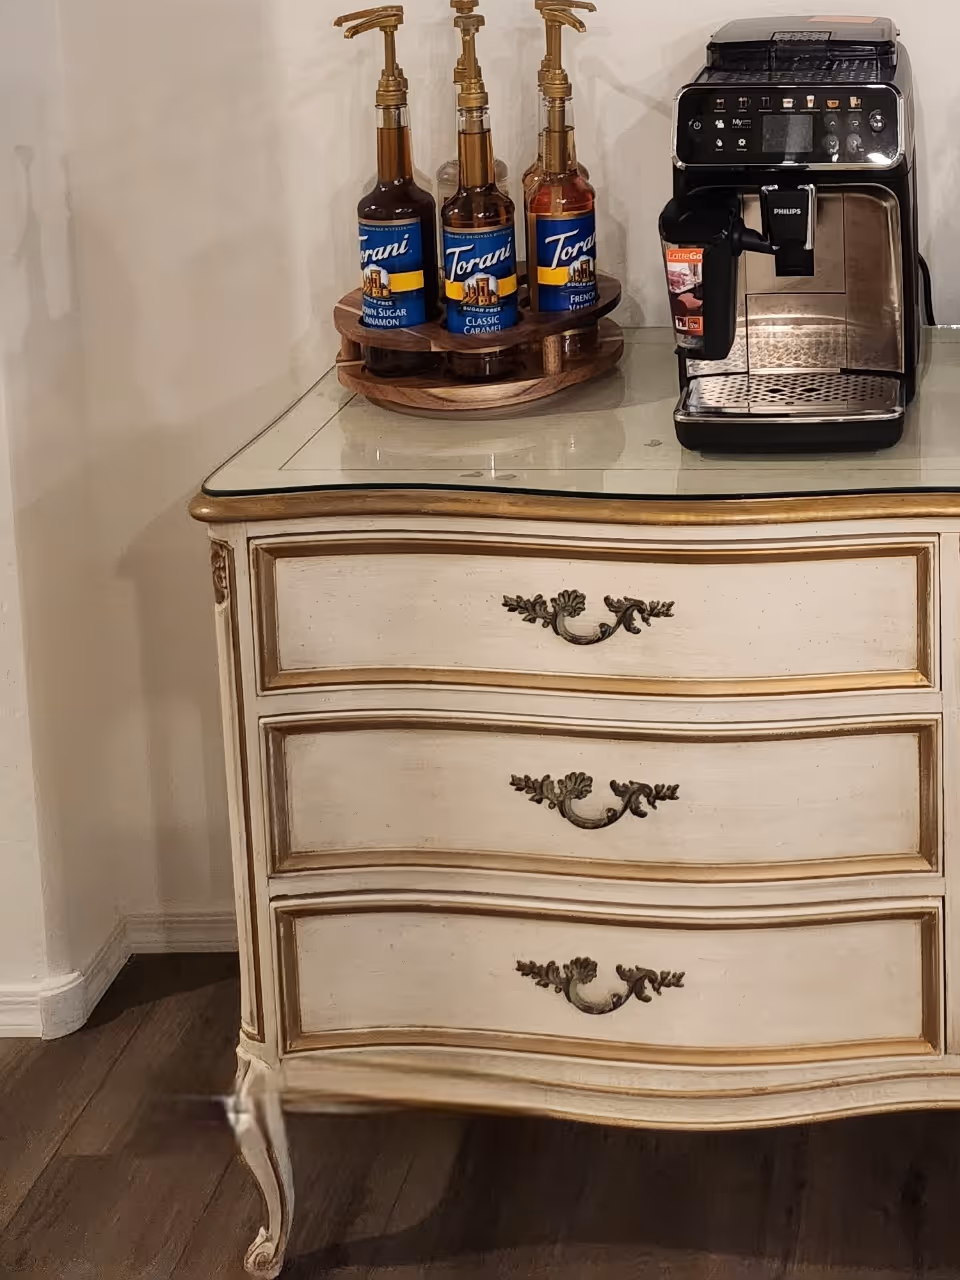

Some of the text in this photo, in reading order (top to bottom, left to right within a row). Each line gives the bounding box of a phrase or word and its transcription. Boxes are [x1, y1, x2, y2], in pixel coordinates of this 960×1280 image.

[445, 236, 512, 283] Torani
[667, 251, 703, 261] LatteGo
[378, 308, 407, 317] SUGAR
[465, 315, 500, 326] CLASSIC
